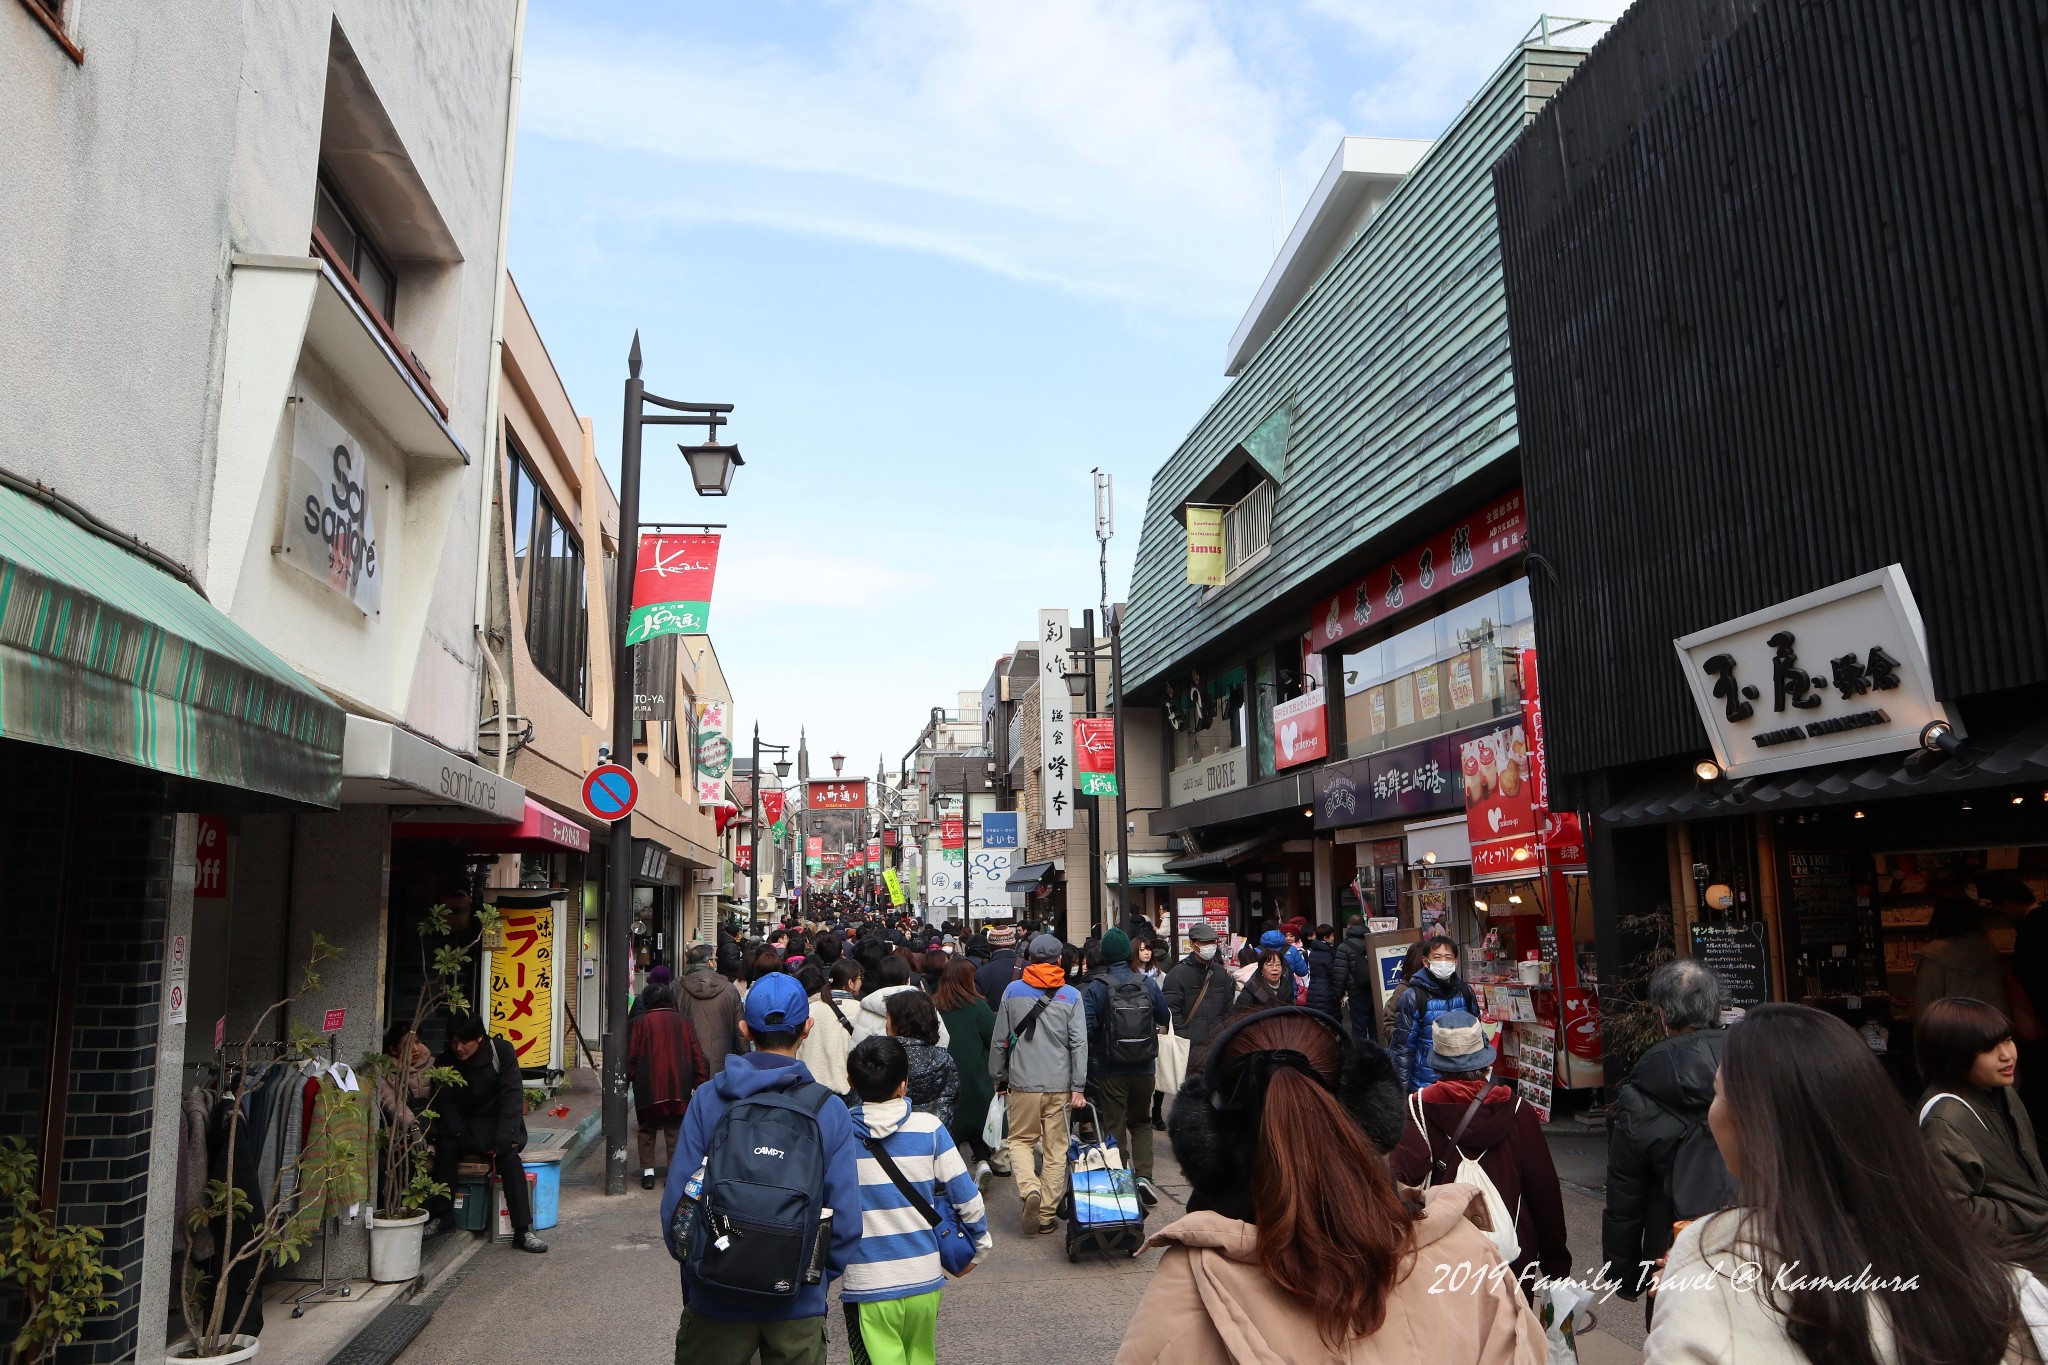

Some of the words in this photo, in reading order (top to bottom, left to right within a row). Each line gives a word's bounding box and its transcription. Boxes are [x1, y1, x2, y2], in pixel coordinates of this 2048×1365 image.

[1190, 543, 1222, 554] imus
[440, 765, 497, 810] santoré
[1206, 761, 1236, 792] MORE
[1373, 759, 1446, 803] 海鮮三崎港
[816, 790, 859, 803] 小町通り
[505, 915, 539, 1058] ラーメン
[326, 1018, 340, 1028] SALE
[492, 974, 509, 1040] ひら
